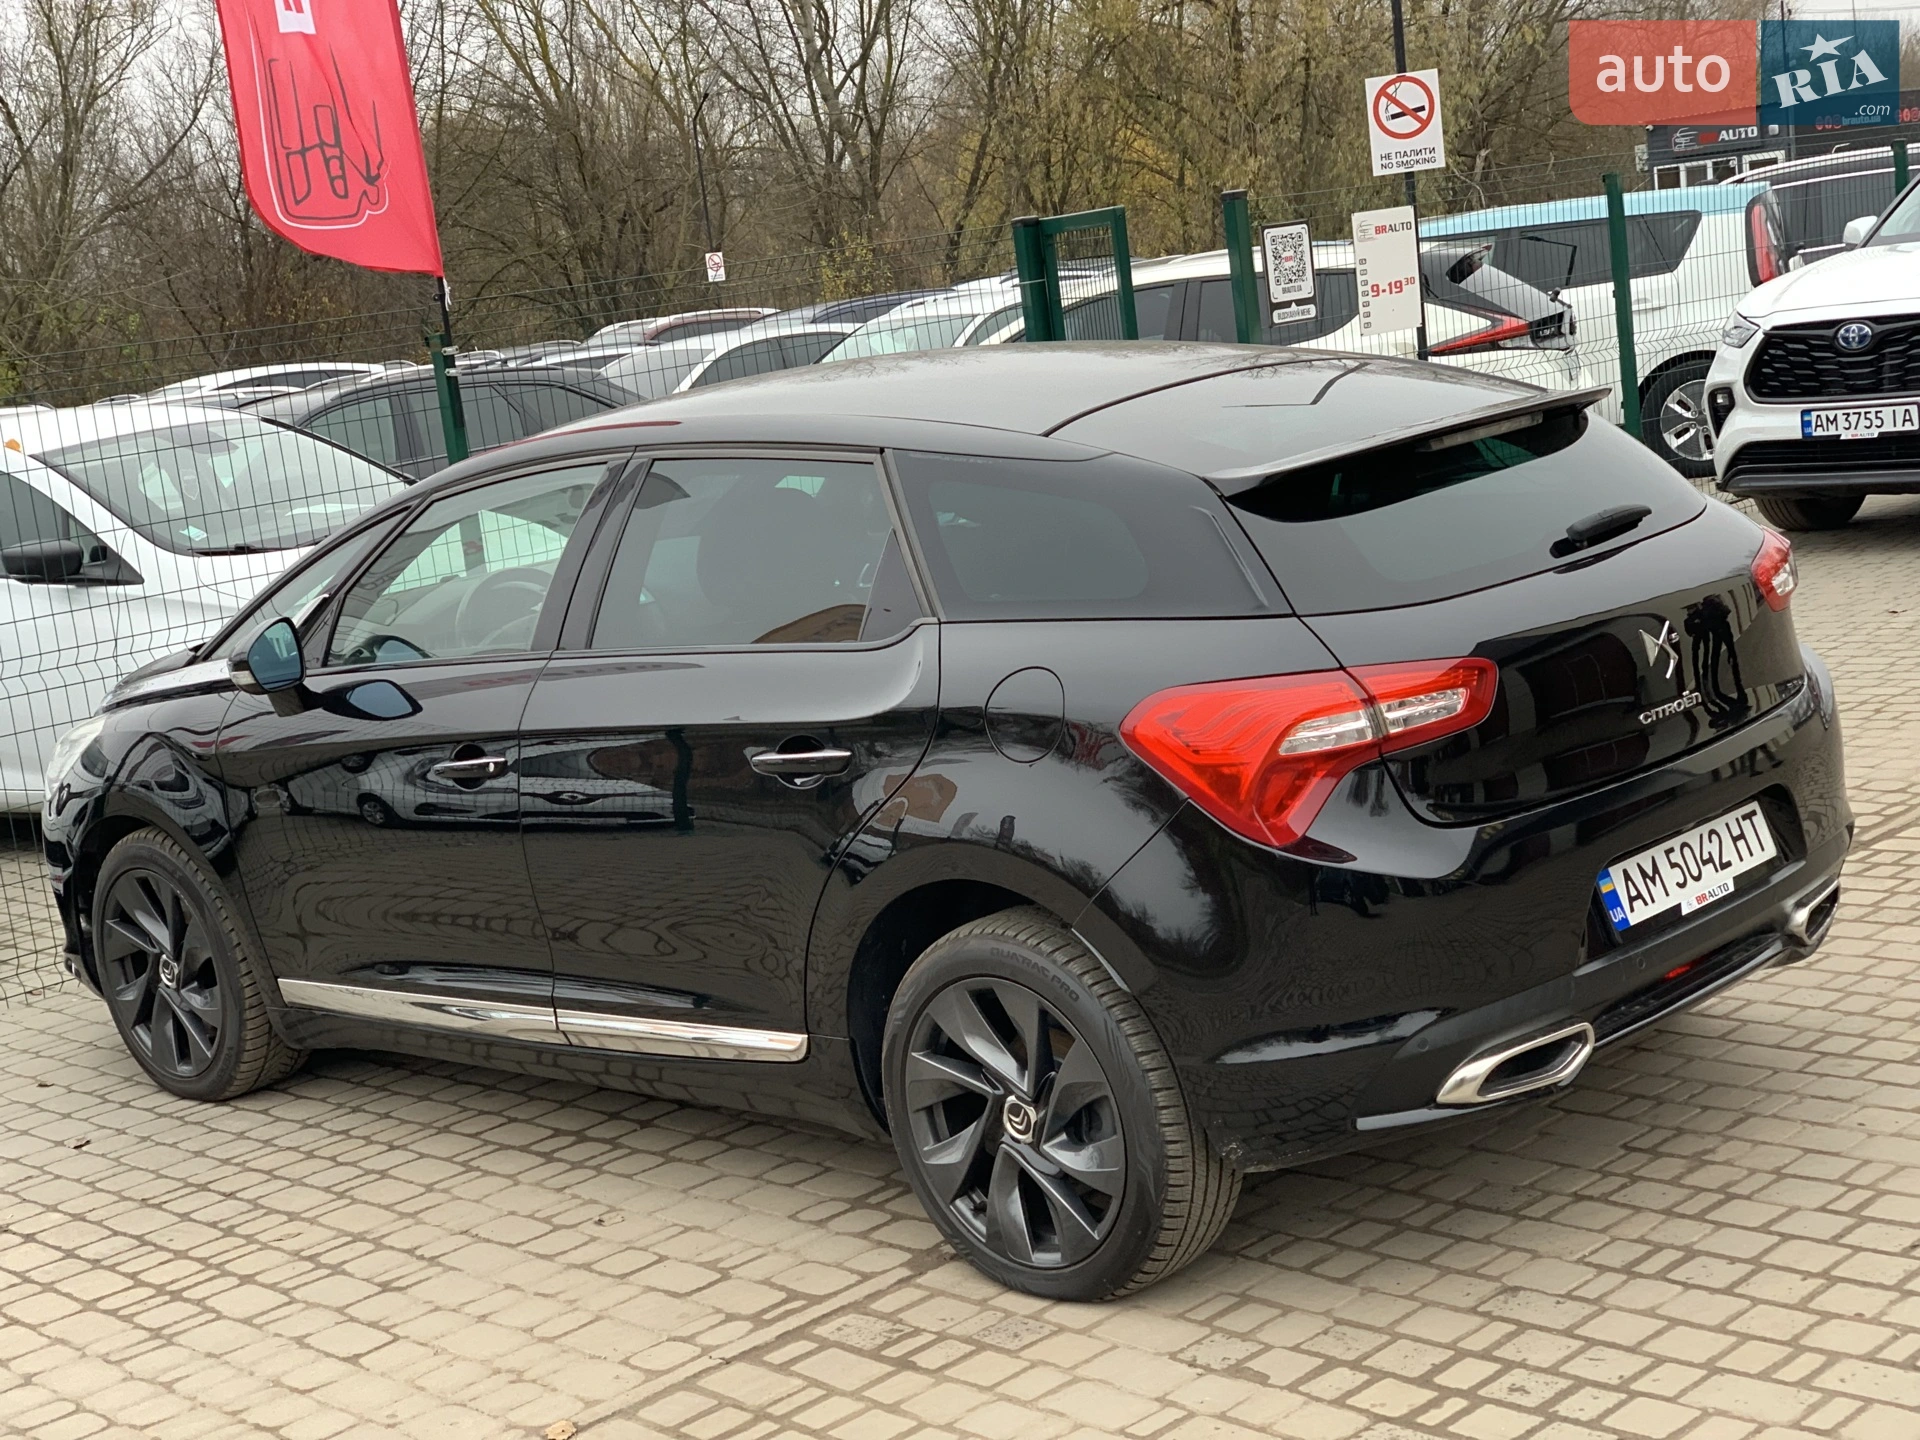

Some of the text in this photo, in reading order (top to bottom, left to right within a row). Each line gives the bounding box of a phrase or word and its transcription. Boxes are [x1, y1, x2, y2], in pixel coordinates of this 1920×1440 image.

[1380, 146, 1436, 161] НЕ ПАЛИТИ
[1380, 156, 1437, 170] NO SMOKING
[1374, 221, 1412, 235] BRAUTO
[1814, 408, 1915, 432] AM 3755 IA
[1622, 809, 1765, 914] AM 5042 HT
[1695, 882, 1730, 905] BRAUTO
[1609, 908, 1626, 923] UA
[990, 946, 1080, 1002] QUATRAC PRO
